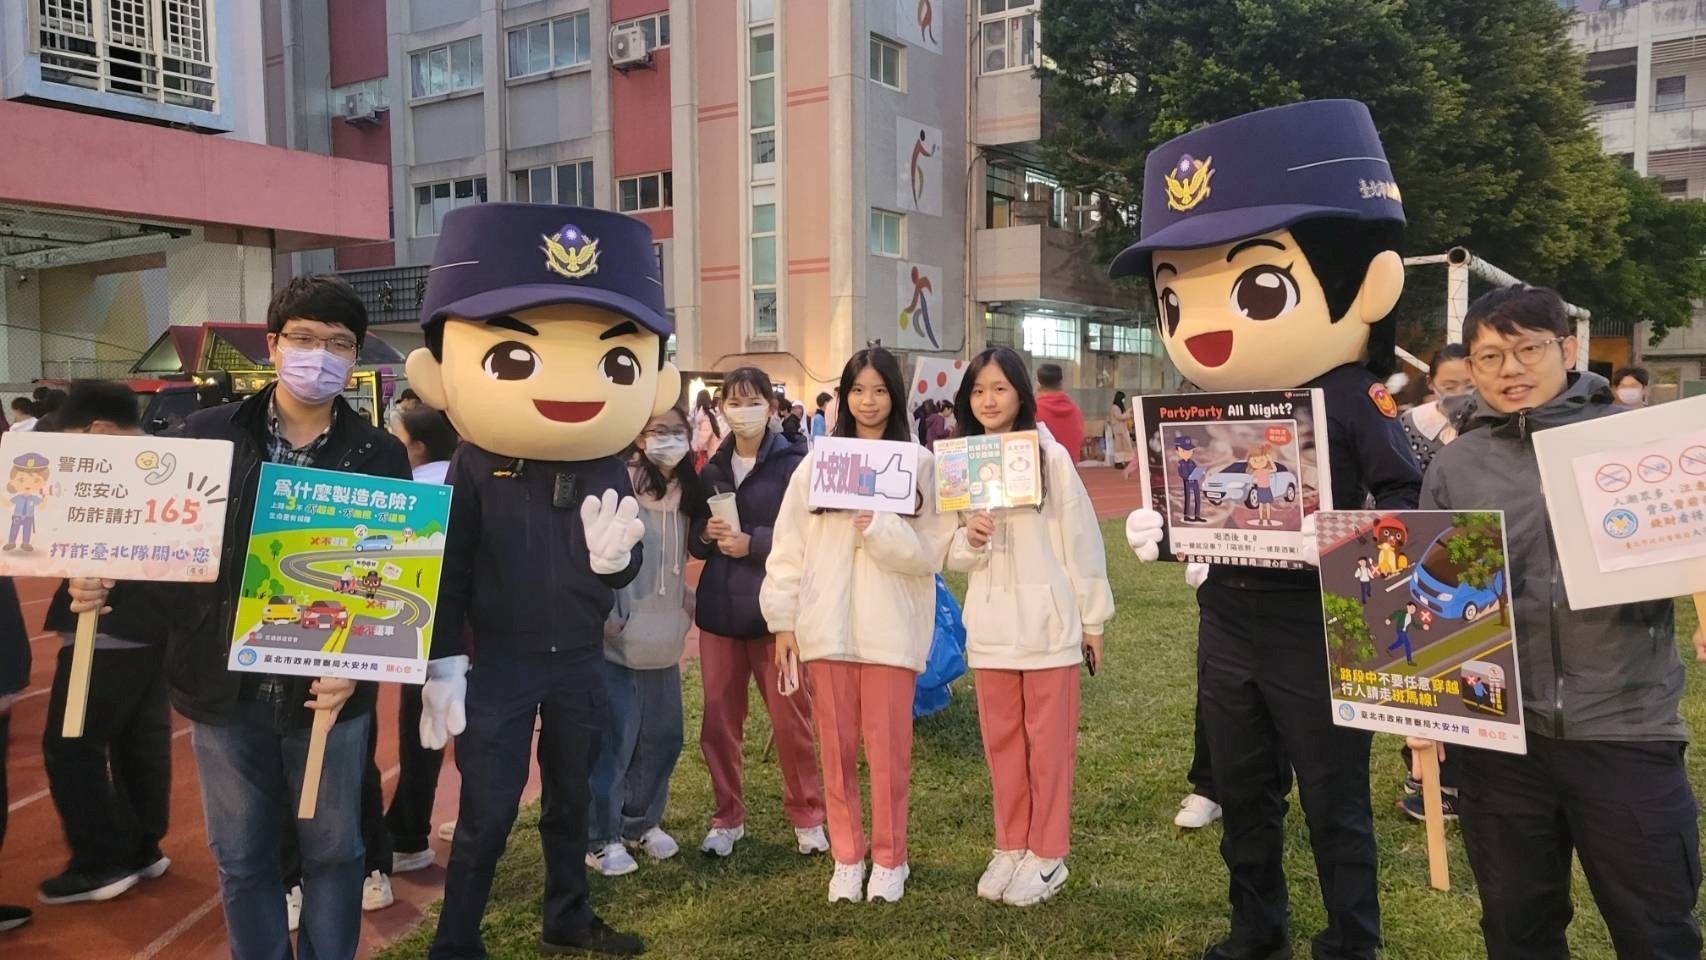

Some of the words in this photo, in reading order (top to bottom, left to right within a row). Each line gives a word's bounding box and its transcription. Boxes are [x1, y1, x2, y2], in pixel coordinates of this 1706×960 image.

[1160, 406, 1223, 420] PartyParty
[1228, 403, 1244, 417] All
[1250, 402, 1293, 418] Night?
[58, 456, 113, 474] 警用心
[74, 482, 129, 499] 您安心
[50, 541, 210, 564] 打詐臺北隊關心您
[263, 654, 379, 671] 臺北市政府警察局大安分局
[385, 663, 412, 674] 關心您
[1339, 667, 1460, 695] 路段中不要任意穿越
[1341, 682, 1439, 707] 行人請走斑馬線!
[1361, 710, 1470, 735] 臺北市政府警察局大安分局
[1478, 727, 1508, 741] 關心您
